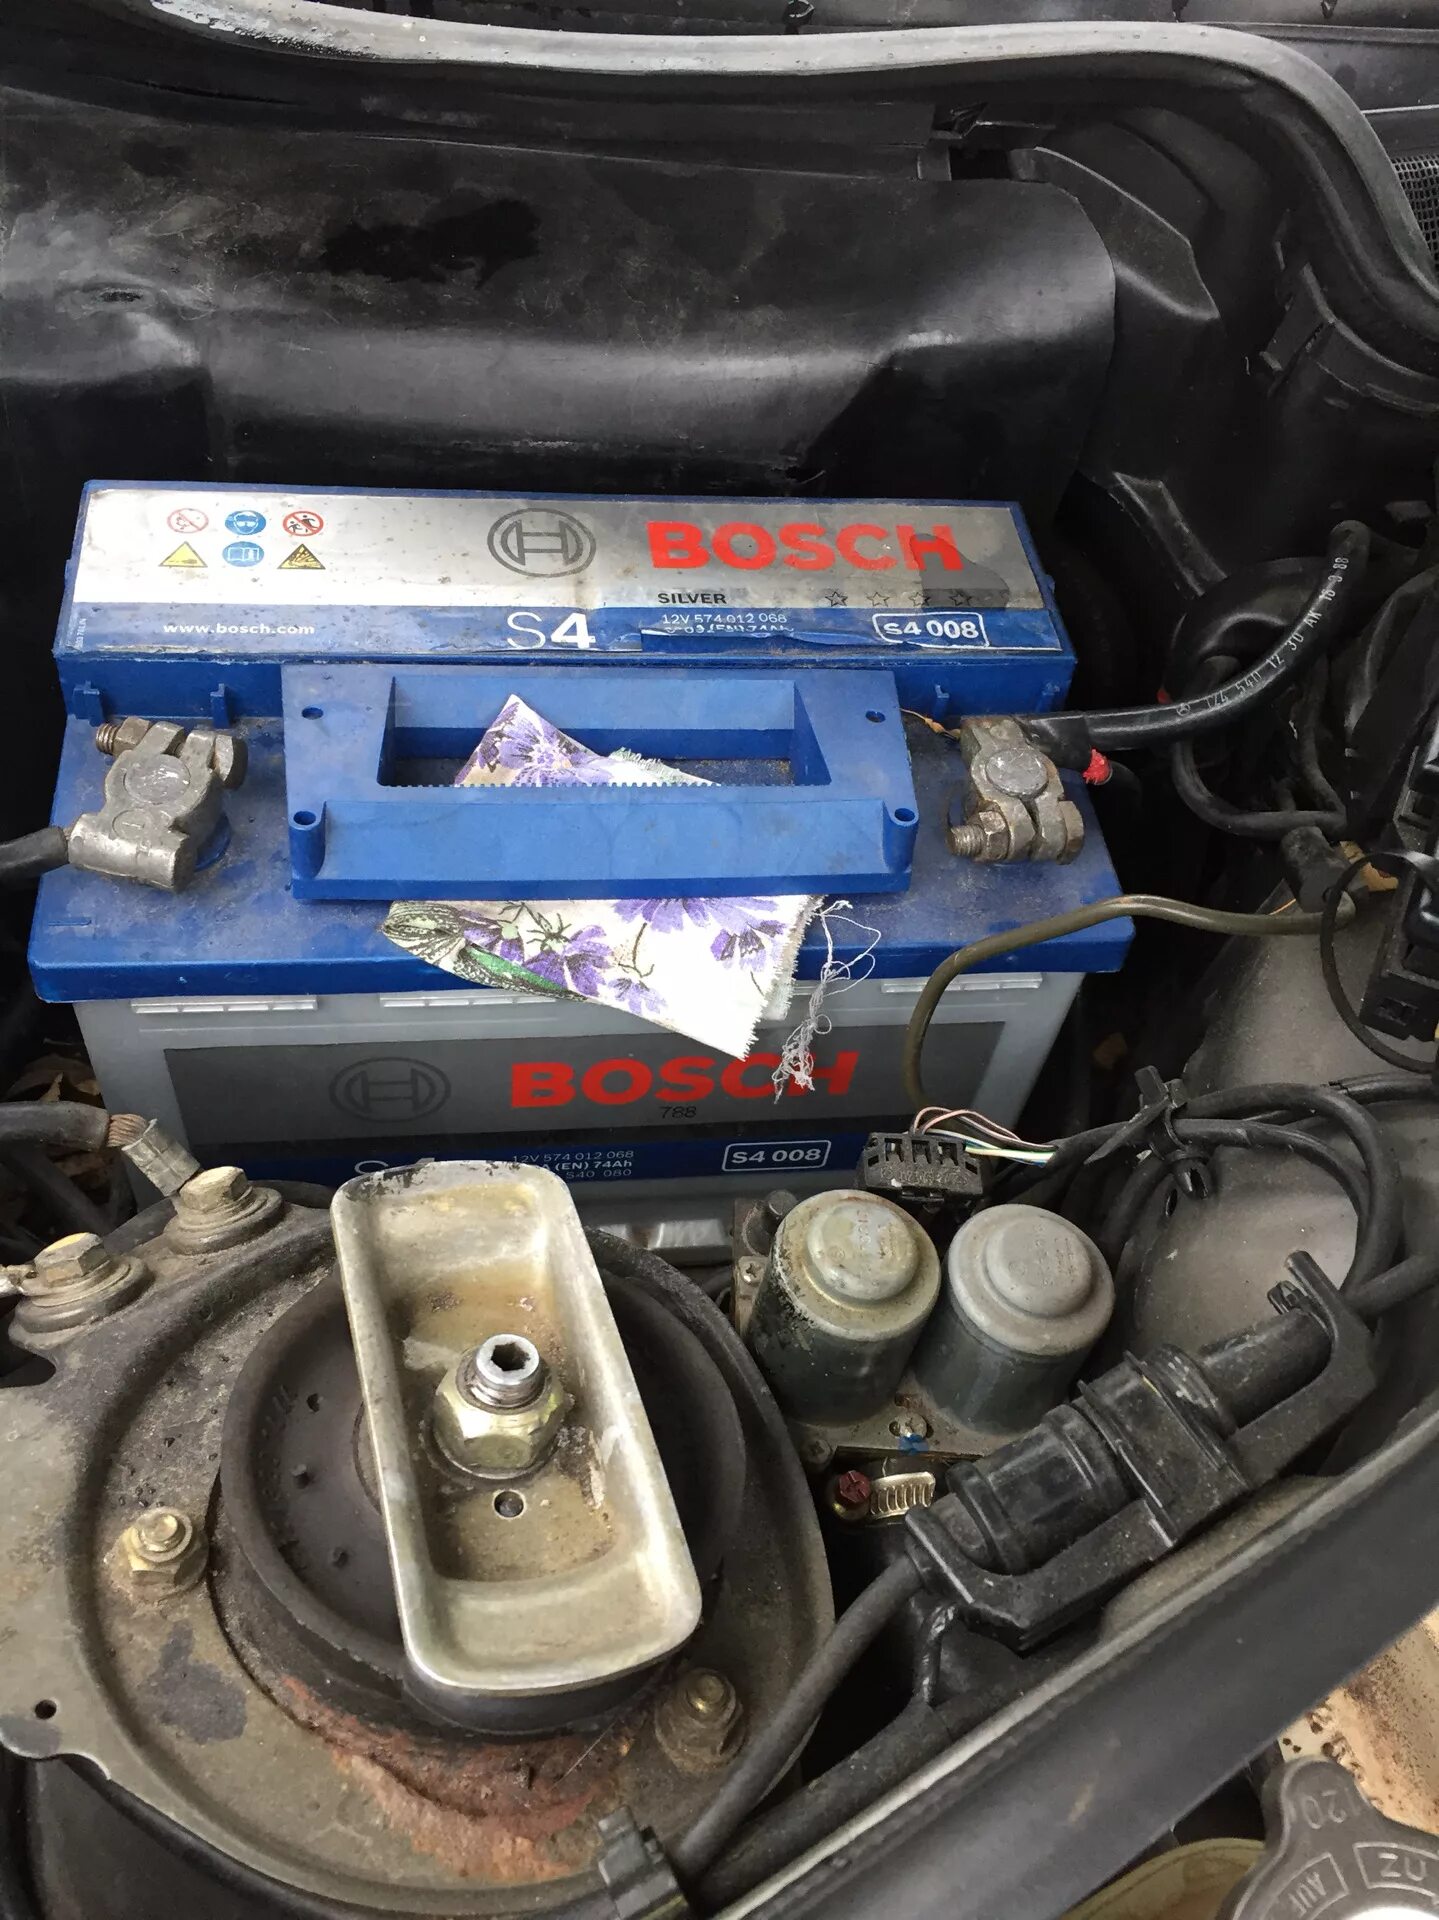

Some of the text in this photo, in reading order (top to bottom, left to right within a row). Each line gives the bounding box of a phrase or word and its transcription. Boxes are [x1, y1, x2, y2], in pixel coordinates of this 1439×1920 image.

[646, 521, 964, 571] BOSCH
[657, 593, 727, 604] SILVER
[662, 613, 788, 625] 12V 574 012 068
[163, 623, 315, 635] www.bosch.com
[507, 611, 596, 649] S4
[883, 620, 979, 639] S4 008
[1266, 653, 1285, 669] 12
[510, 1051, 860, 1109] BOSCH
[513, 1150, 634, 1164] 12V 574 012 068
[732, 1148, 822, 1164] S4 008
[555, 1161, 589, 1171] (EN)
[594, 1160, 633, 1169] 74Ah
[1378, 1852, 1427, 1882] ZU
